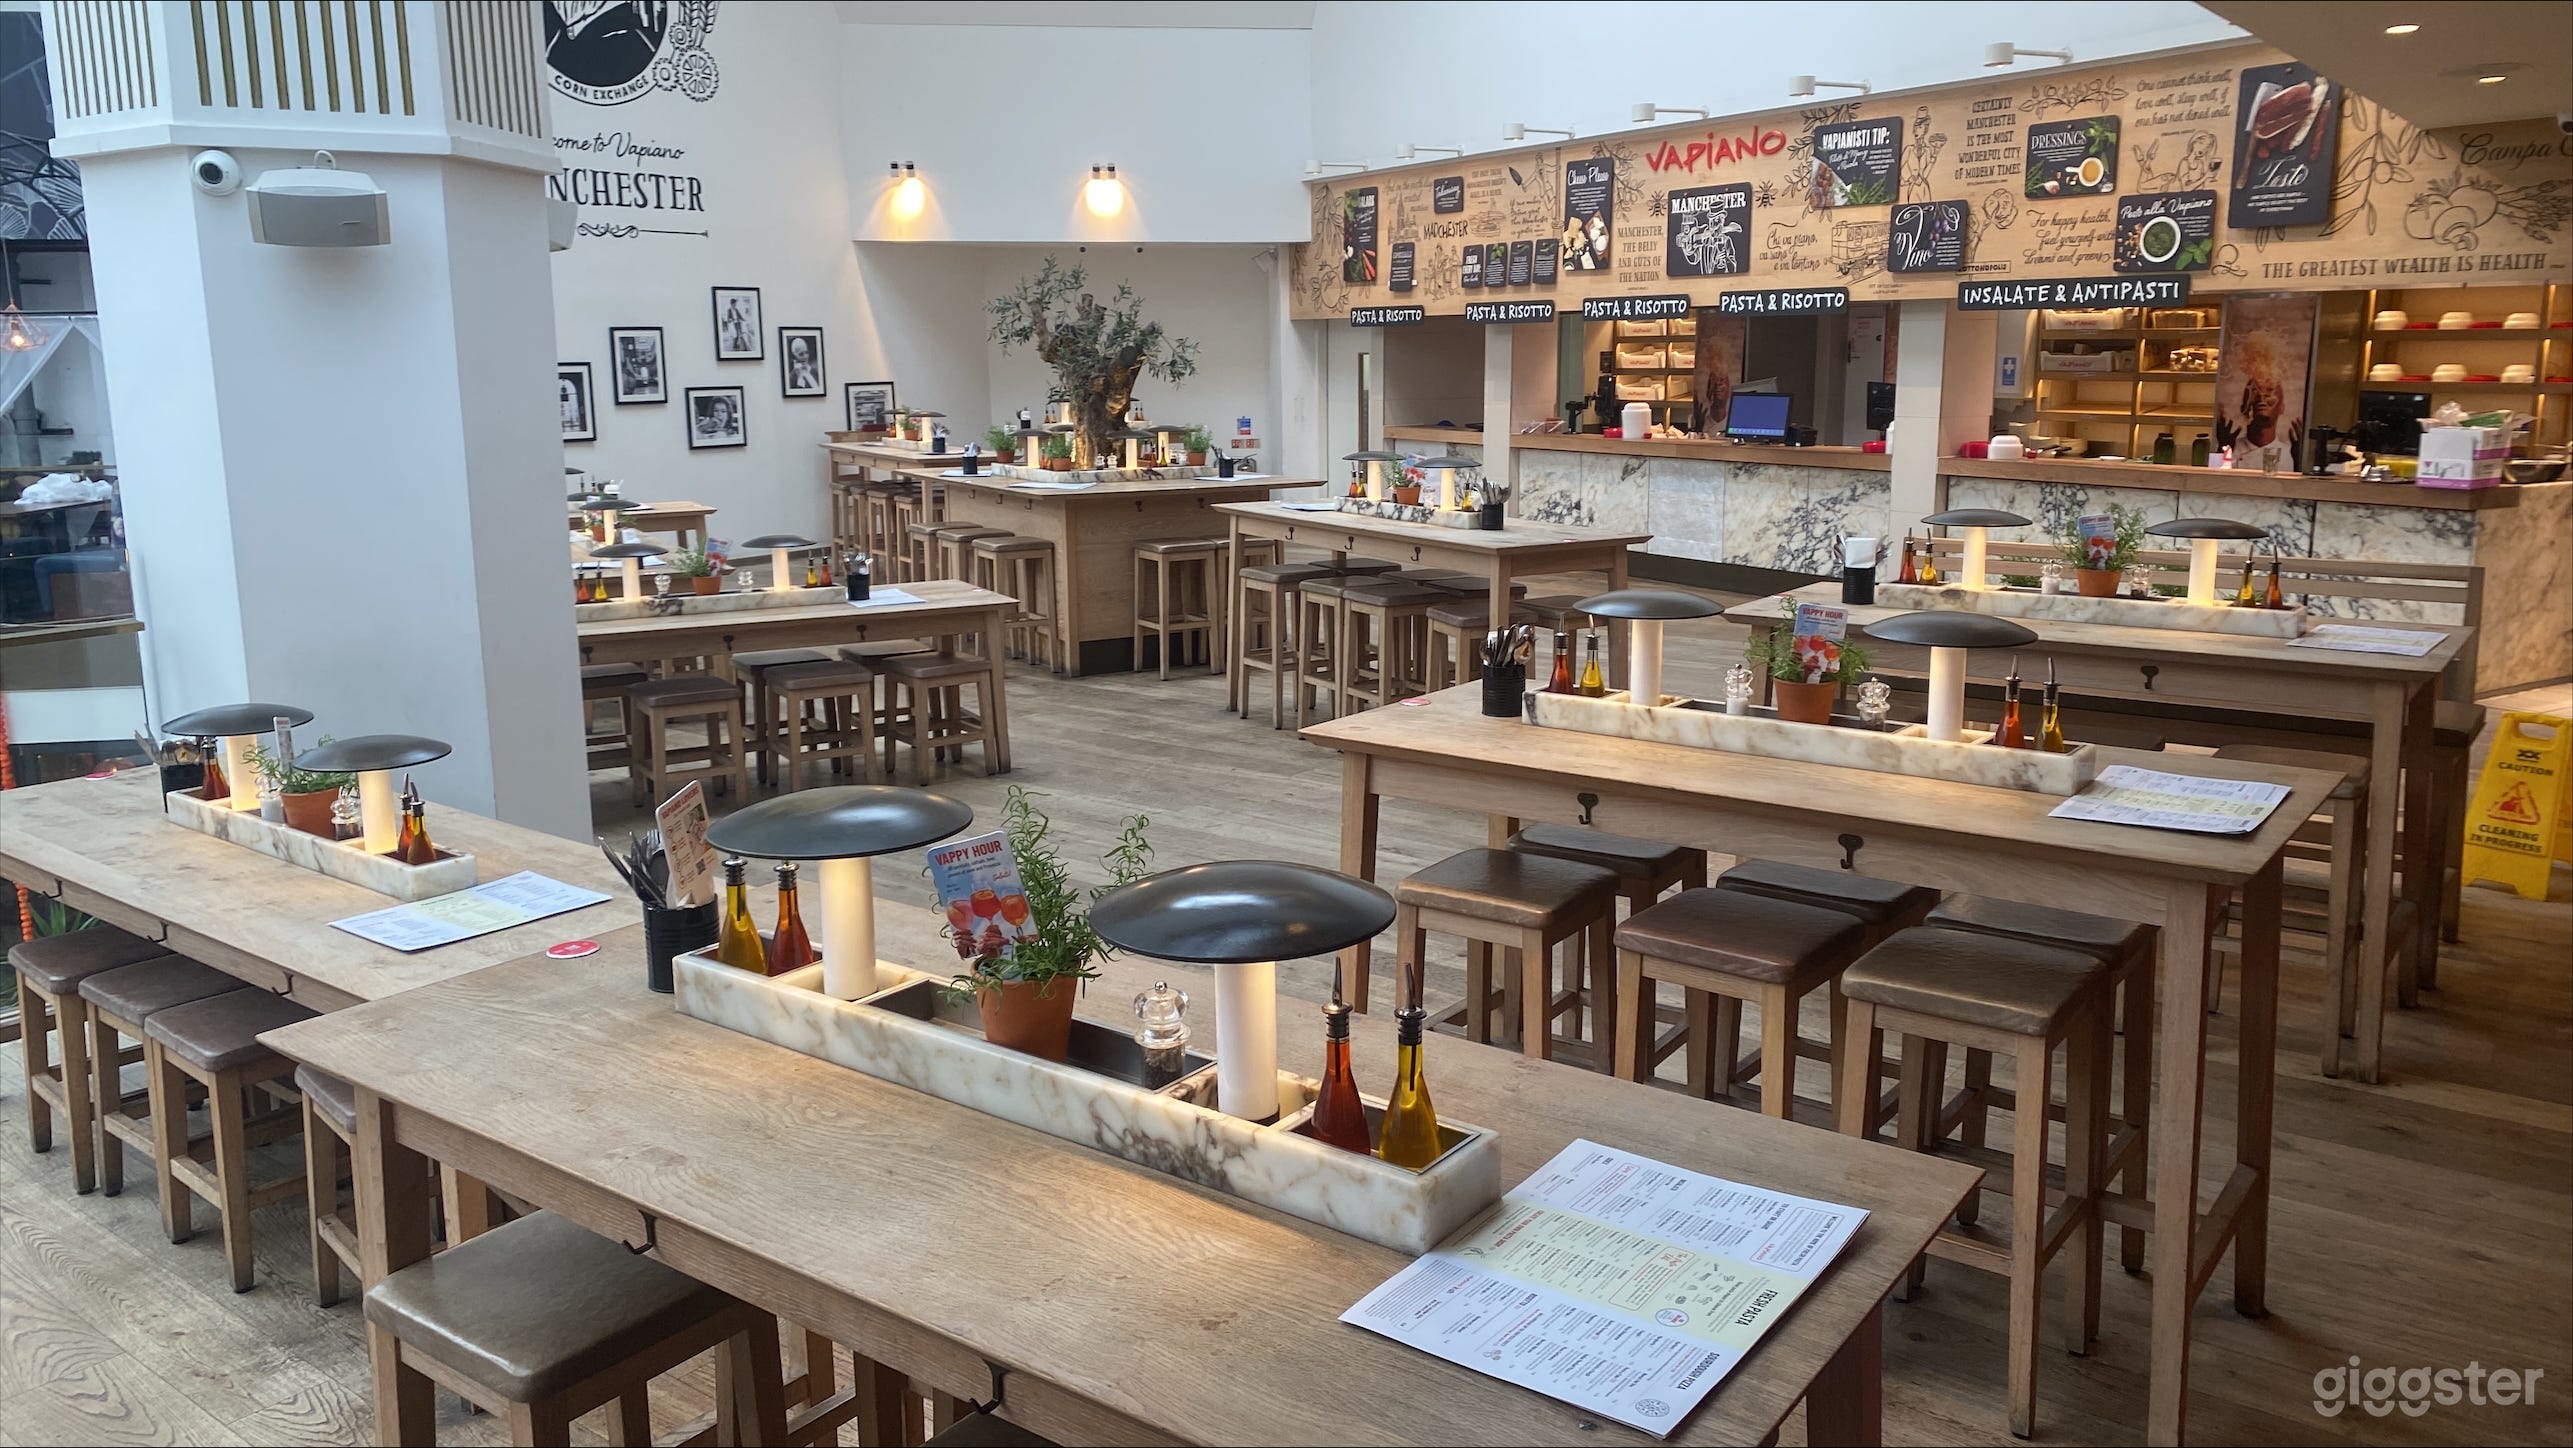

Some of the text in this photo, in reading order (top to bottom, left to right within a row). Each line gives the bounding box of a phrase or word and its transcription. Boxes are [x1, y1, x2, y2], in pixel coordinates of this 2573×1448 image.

[555, 75, 649, 100] CORN EXCHANGE
[1967, 114, 2016, 130] MANCHESTER
[1823, 127, 1890, 149] VAPIANISTI TIP:
[1967, 131, 2014, 146] IS THE MOST
[2031, 130, 2086, 149] DRESSINGS
[593, 132, 604, 152] to
[608, 132, 685, 167] Vapiano
[1646, 125, 1787, 173] VAPIANO
[1959, 149, 2000, 163] WONDERFUL
[2004, 147, 2021, 158] CITY
[2460, 133, 2551, 170] Campa
[1966, 166, 1995, 178] MODERN
[2167, 198, 2213, 215] Vapiano
[1424, 220, 1468, 240] MADCHESTER
[1623, 241, 1657, 252] THE BELLY
[2057, 248, 2078, 263] and
[1619, 256, 1662, 267] AND GUTS OF
[1959, 264, 2006, 272] OTTONOPOLIS
[2264, 253, 2547, 278] THE GREATEST WEALTH IS HEALTH
[1620, 271, 1659, 282] THE NATION
[1964, 280, 2179, 304] INSALATE & ANTIPASTI
[1584, 300, 1686, 318] PASTA & RISOTTO
[1721, 293, 1845, 313] PASTA & RISOTTO
[1352, 310, 1422, 324] PASTA & RISOTTO
[1467, 304, 1552, 321] PASTA & RISOTTO
[1826, 611, 1843, 619] HOUR
[2498, 762, 2554, 776] CAUTION
[2479, 824, 2539, 842] CLEANING
[2470, 834, 2542, 853] IN PROGRESS
[935, 848, 968, 866] VAPPY
[972, 840, 1003, 857] HOUR
[1733, 1288, 1778, 1327] FRESH PASTA
[1675, 1351, 1720, 1391] SOURDOUGH PIZZA
